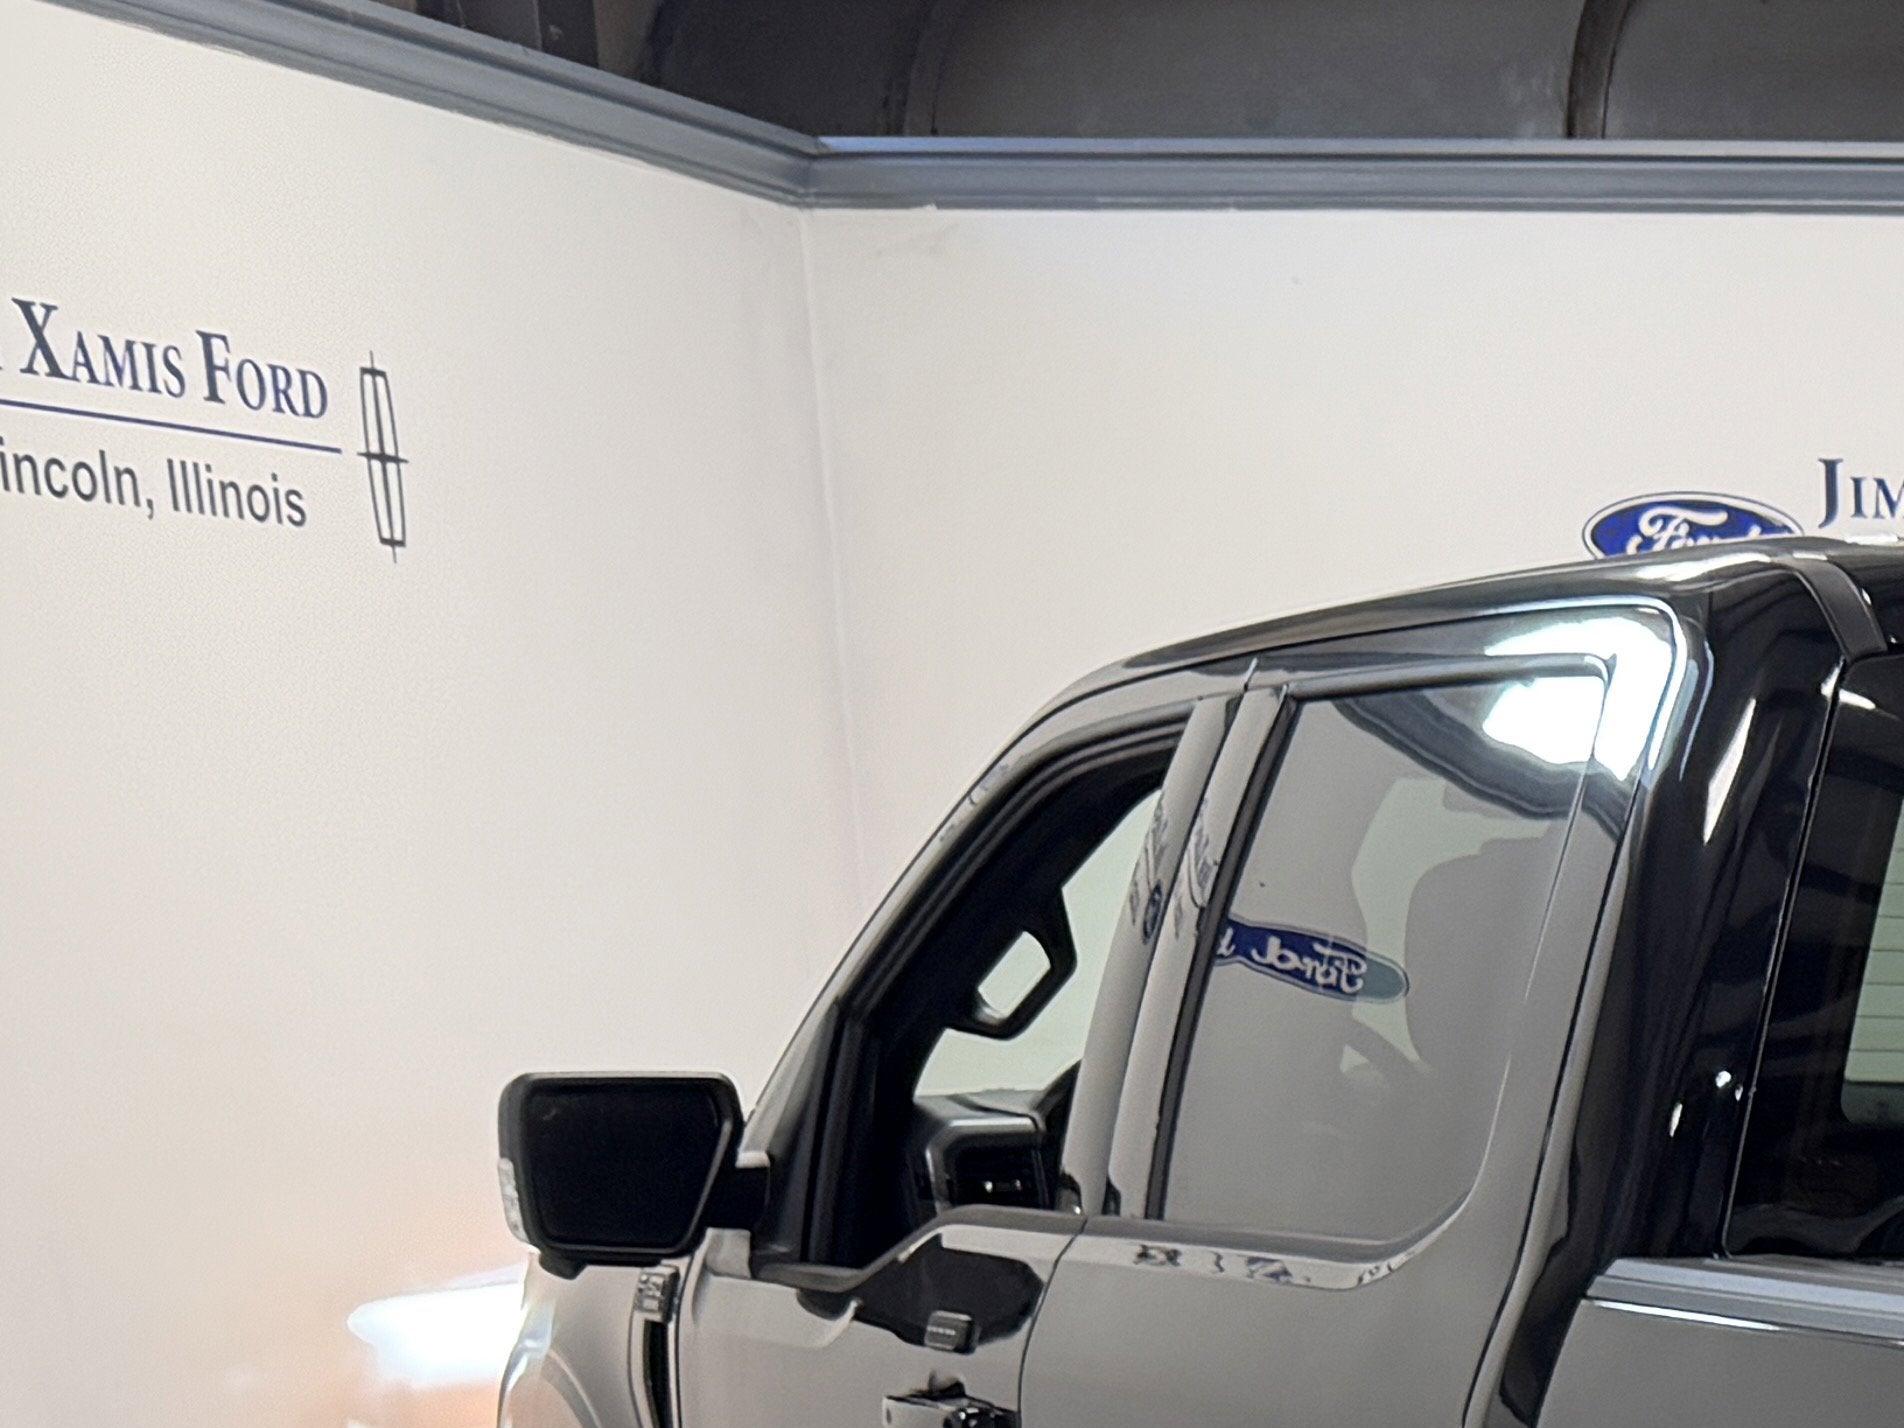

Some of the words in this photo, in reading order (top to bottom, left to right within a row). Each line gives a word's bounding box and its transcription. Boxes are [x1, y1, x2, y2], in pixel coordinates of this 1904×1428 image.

[195, 330, 328, 420] FORD
[0, 437, 155, 519] incoln,
[166, 458, 307, 528] Illinois
